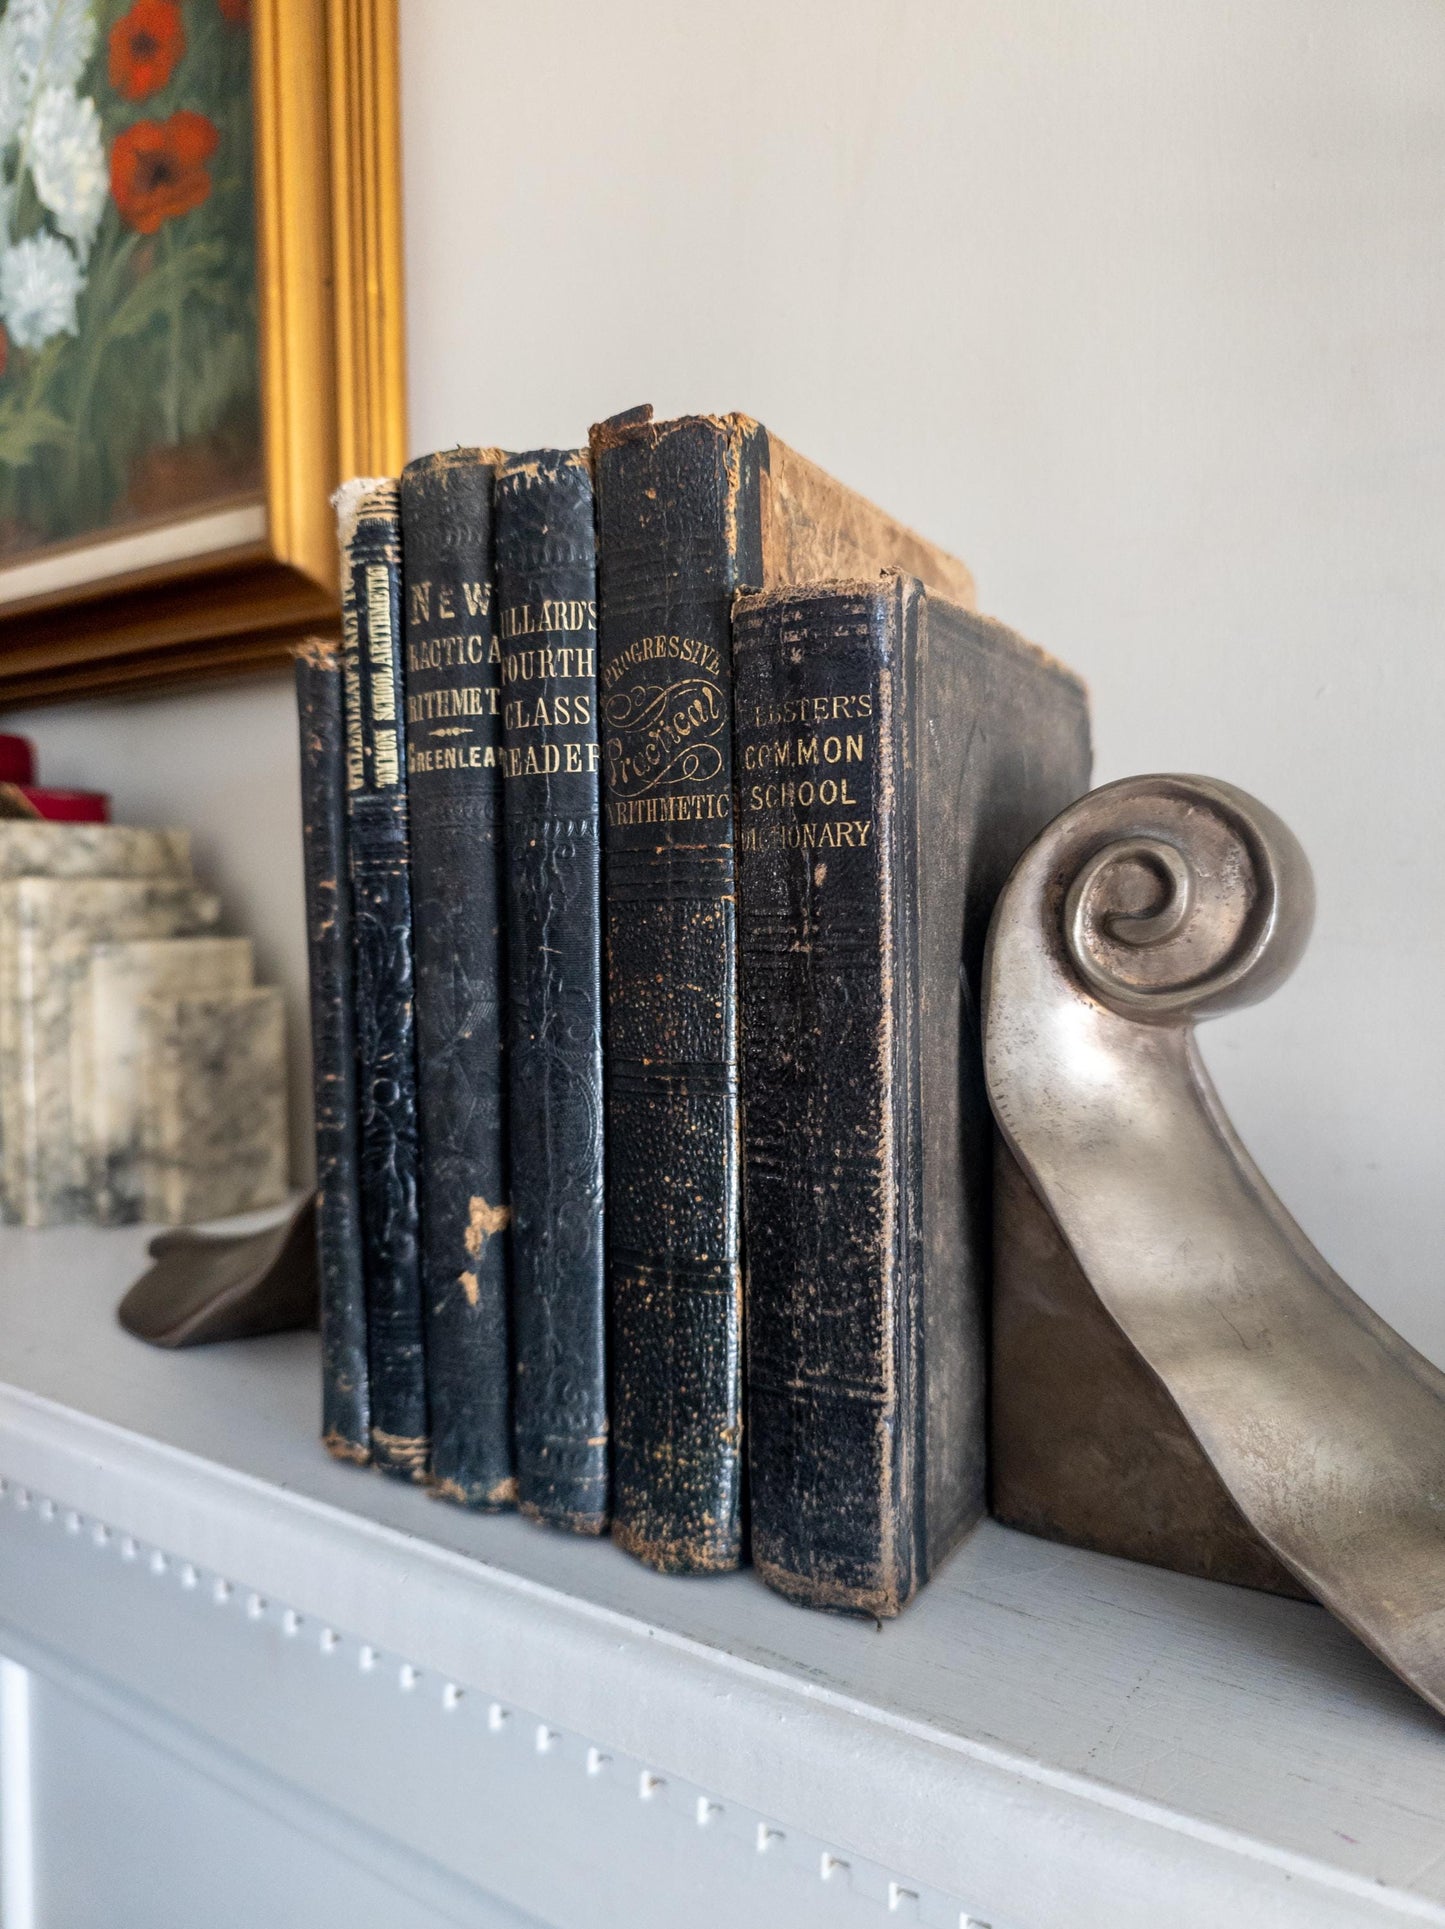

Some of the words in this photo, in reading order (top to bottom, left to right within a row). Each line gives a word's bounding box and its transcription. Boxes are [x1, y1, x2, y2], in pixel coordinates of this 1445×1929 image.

[410, 581, 492, 625] NEW
[505, 695, 591, 731] CLASS
[745, 734, 864, 770] COMMON
[750, 779, 857, 810] SCHOOL
